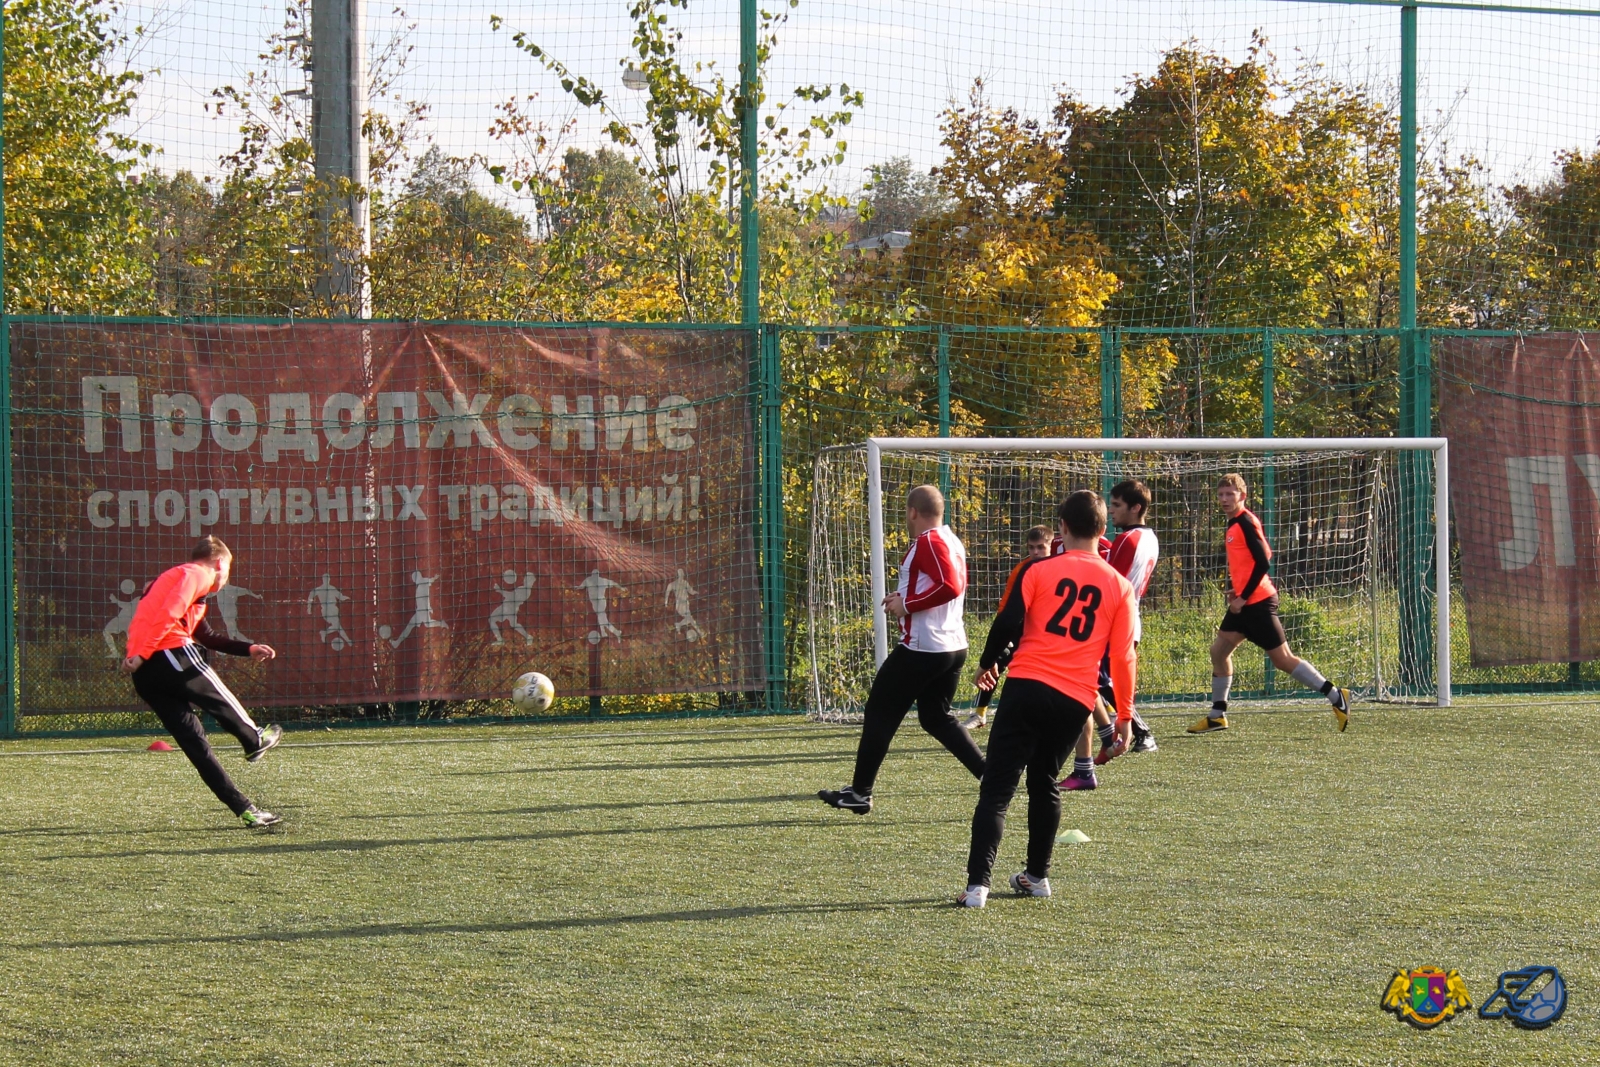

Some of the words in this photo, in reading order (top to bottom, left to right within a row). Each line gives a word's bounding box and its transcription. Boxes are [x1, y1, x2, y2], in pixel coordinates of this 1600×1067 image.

[82, 375, 698, 470] Продолжение
[87, 484, 426, 537] спортивных
[438, 473, 701, 531] традиций!
[1045, 577, 1102, 642] 23
